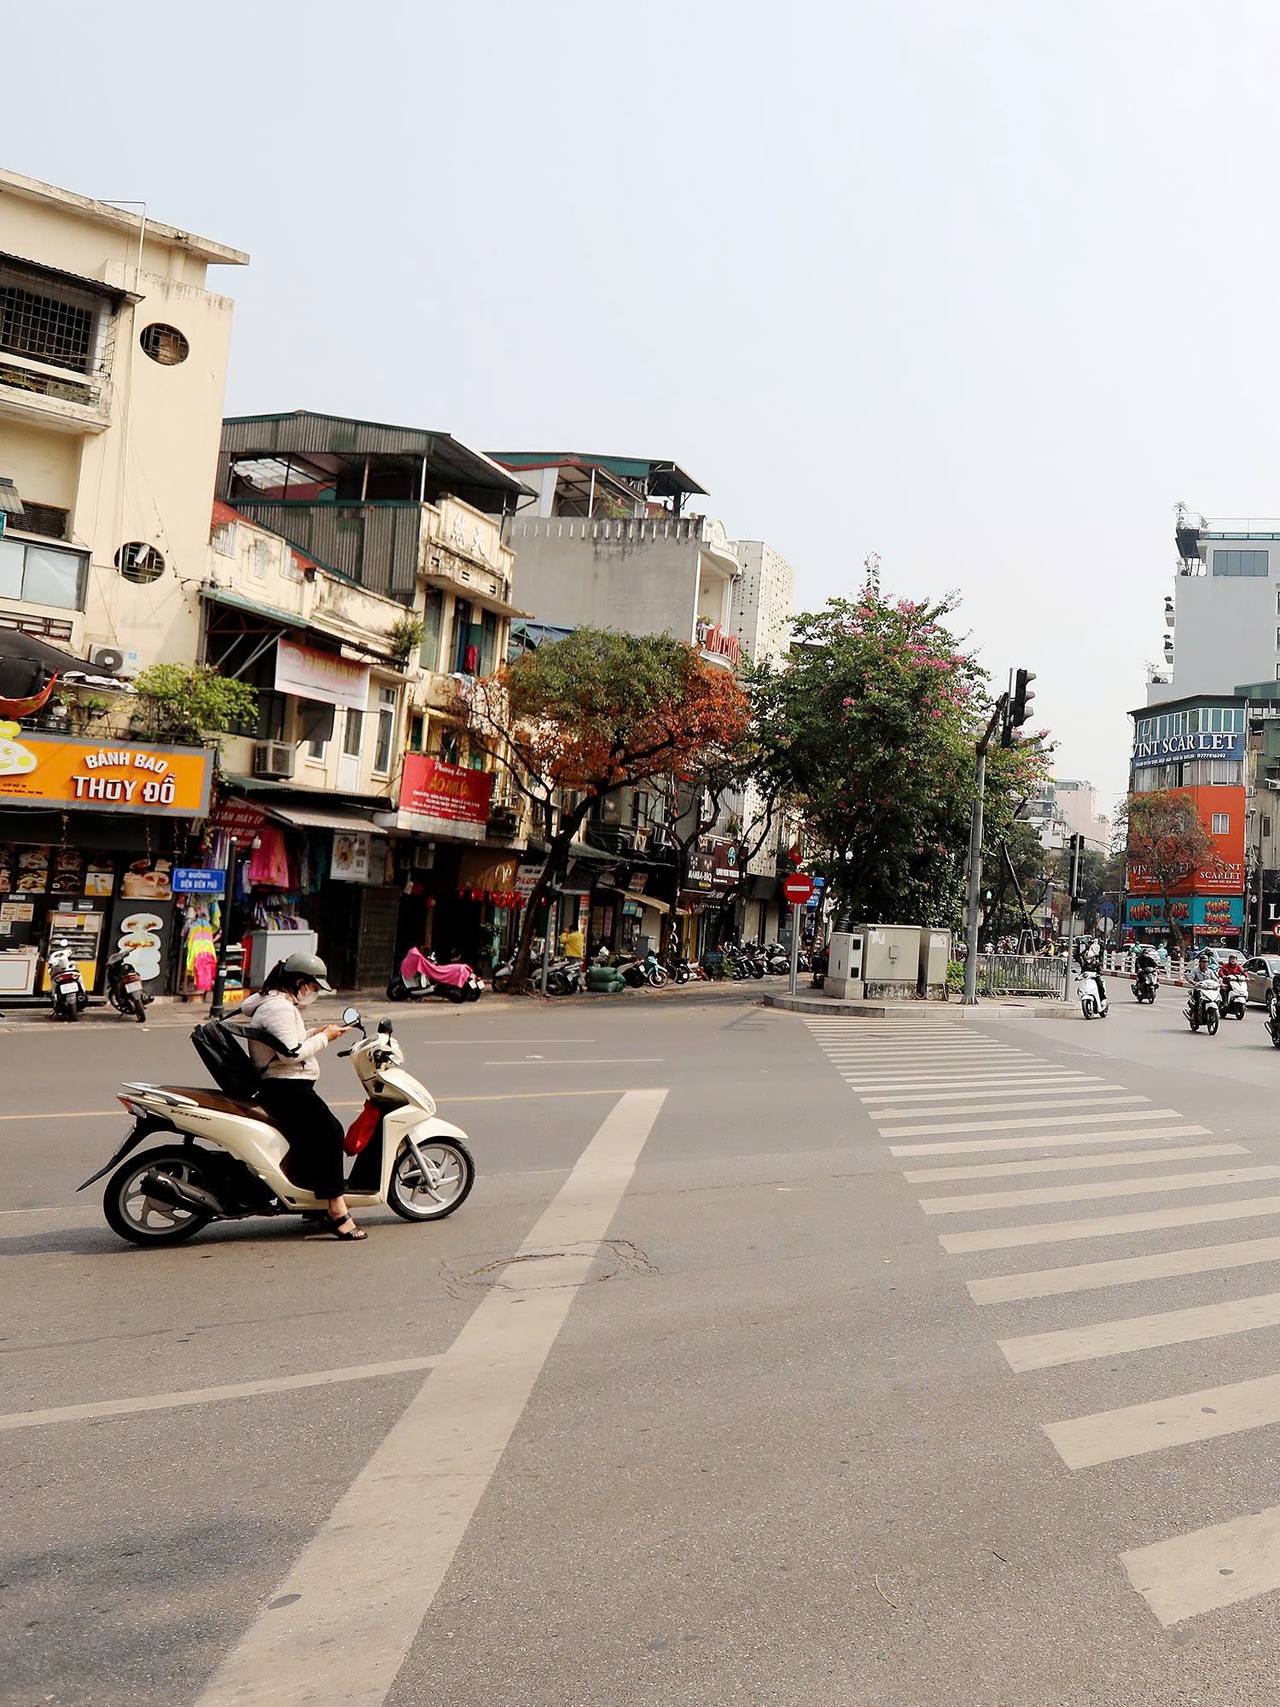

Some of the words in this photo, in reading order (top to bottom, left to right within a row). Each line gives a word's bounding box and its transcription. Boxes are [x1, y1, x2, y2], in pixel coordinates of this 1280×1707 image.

[1133, 740, 1160, 758] VINT
[85, 748, 131, 769] BÁNH
[134, 753, 168, 774] BAO
[142, 772, 177, 804] ĐỖ
[1200, 871, 1242, 880] SCARLET
